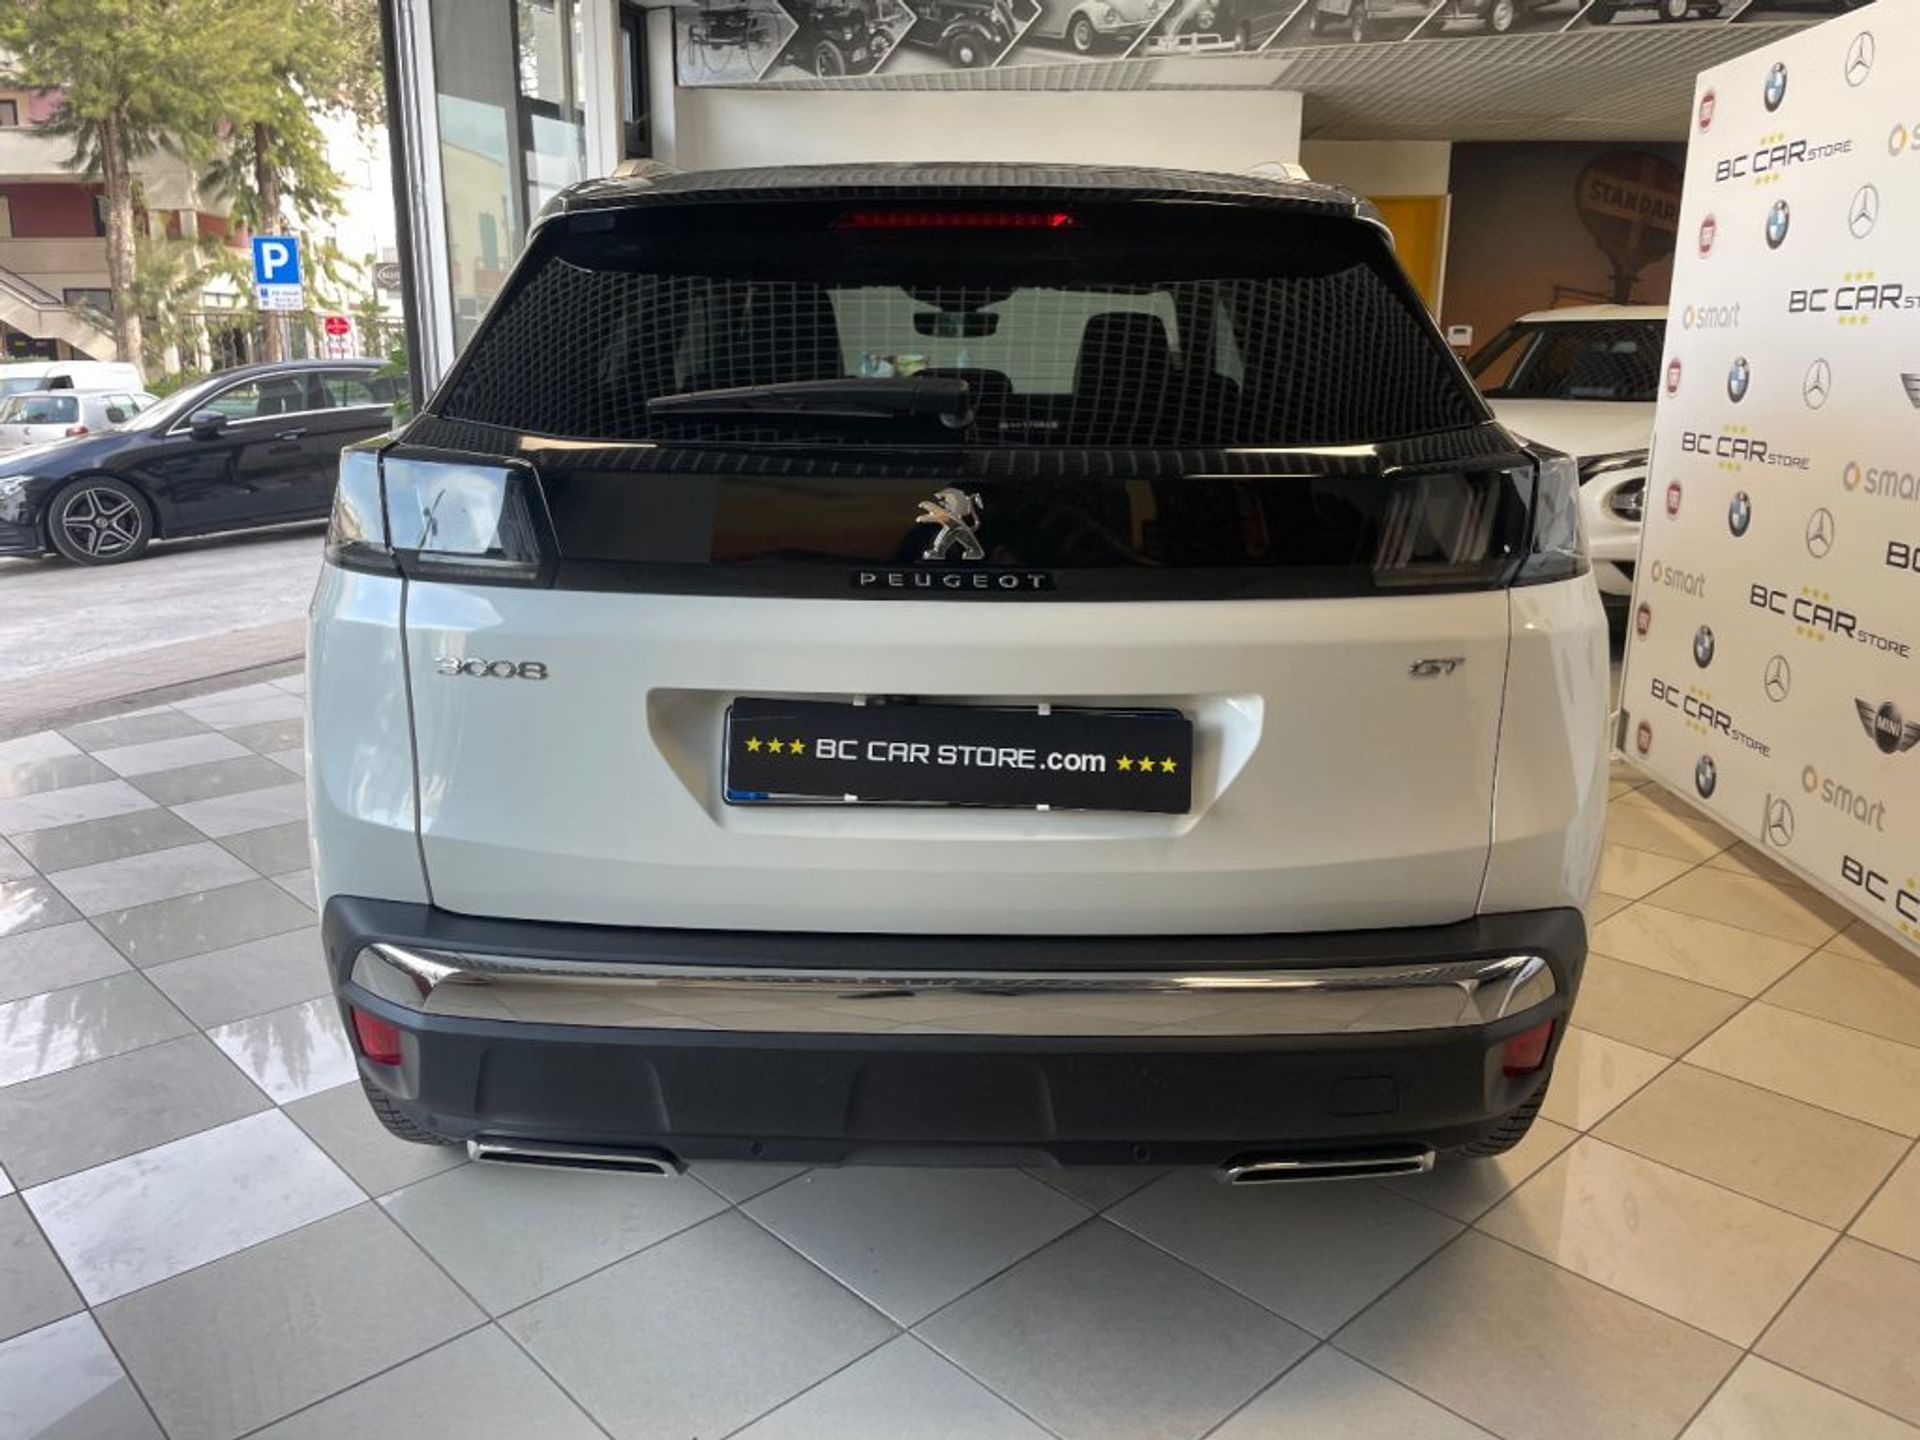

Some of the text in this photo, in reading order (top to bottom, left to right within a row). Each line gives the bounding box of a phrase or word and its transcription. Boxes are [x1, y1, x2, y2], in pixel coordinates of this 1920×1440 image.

[1715, 139, 1853, 182] BC CAR STORE
[262, 242, 289, 279] P
[1788, 289, 1829, 313] BC
[1834, 283, 1903, 310] CAR
[1696, 302, 1741, 329] smart
[1681, 431, 1810, 470] BC CAR STORE
[859, 572, 1047, 589] PEUGEOT
[1664, 566, 1706, 598] smart
[1750, 583, 1911, 660] BC CAR STORE
[434, 657, 549, 680] 3008
[1408, 656, 1466, 679] GT
[1651, 677, 1771, 758] BC CAR STORE
[815, 738, 858, 761] BC
[867, 741, 930, 765] CAR
[1821, 778, 1887, 832] smart
[1841, 855, 1889, 902] BC
